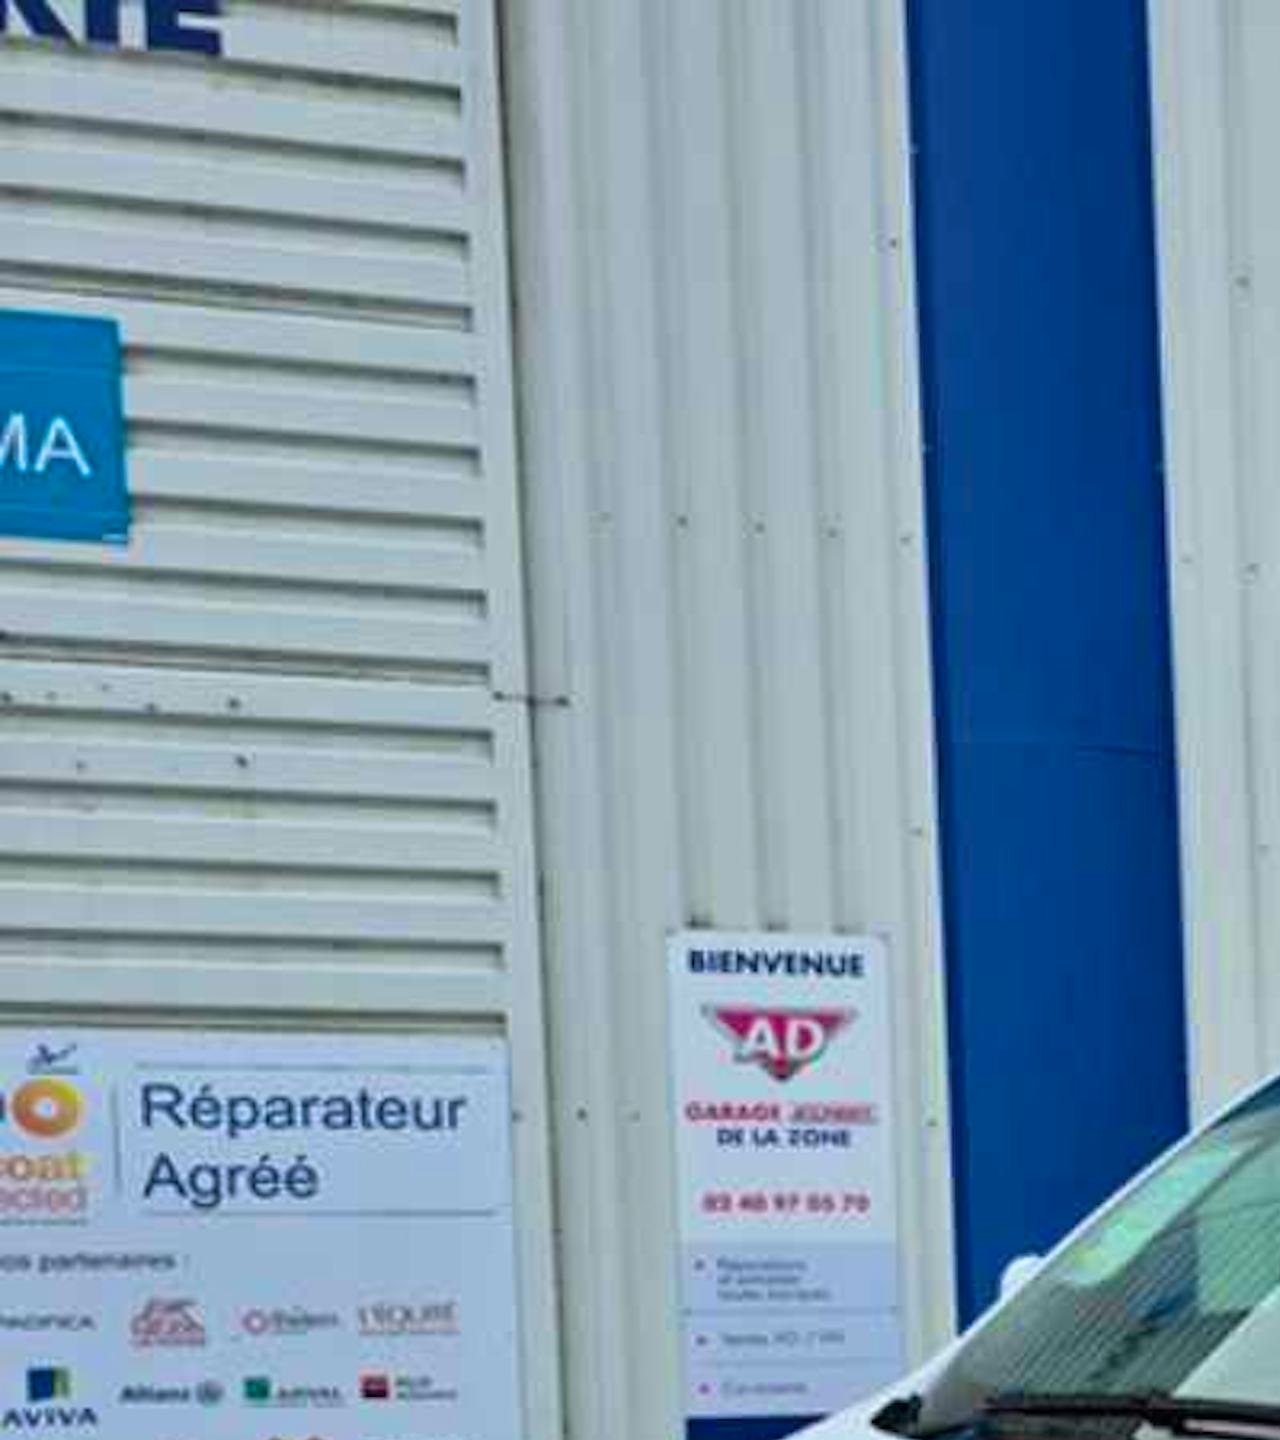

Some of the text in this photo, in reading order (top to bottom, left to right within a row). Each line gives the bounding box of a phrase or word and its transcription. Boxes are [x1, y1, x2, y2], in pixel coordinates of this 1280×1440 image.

[688, 950, 866, 976] BIENVENUE
[734, 1017, 825, 1061] AD
[140, 1080, 467, 1138] Réparateur
[685, 1102, 780, 1122] GARAGE
[716, 1129, 850, 1148] DE LA ZONE
[143, 1151, 320, 1210] Agréé
[2, 1408, 97, 1428] AVIVA
